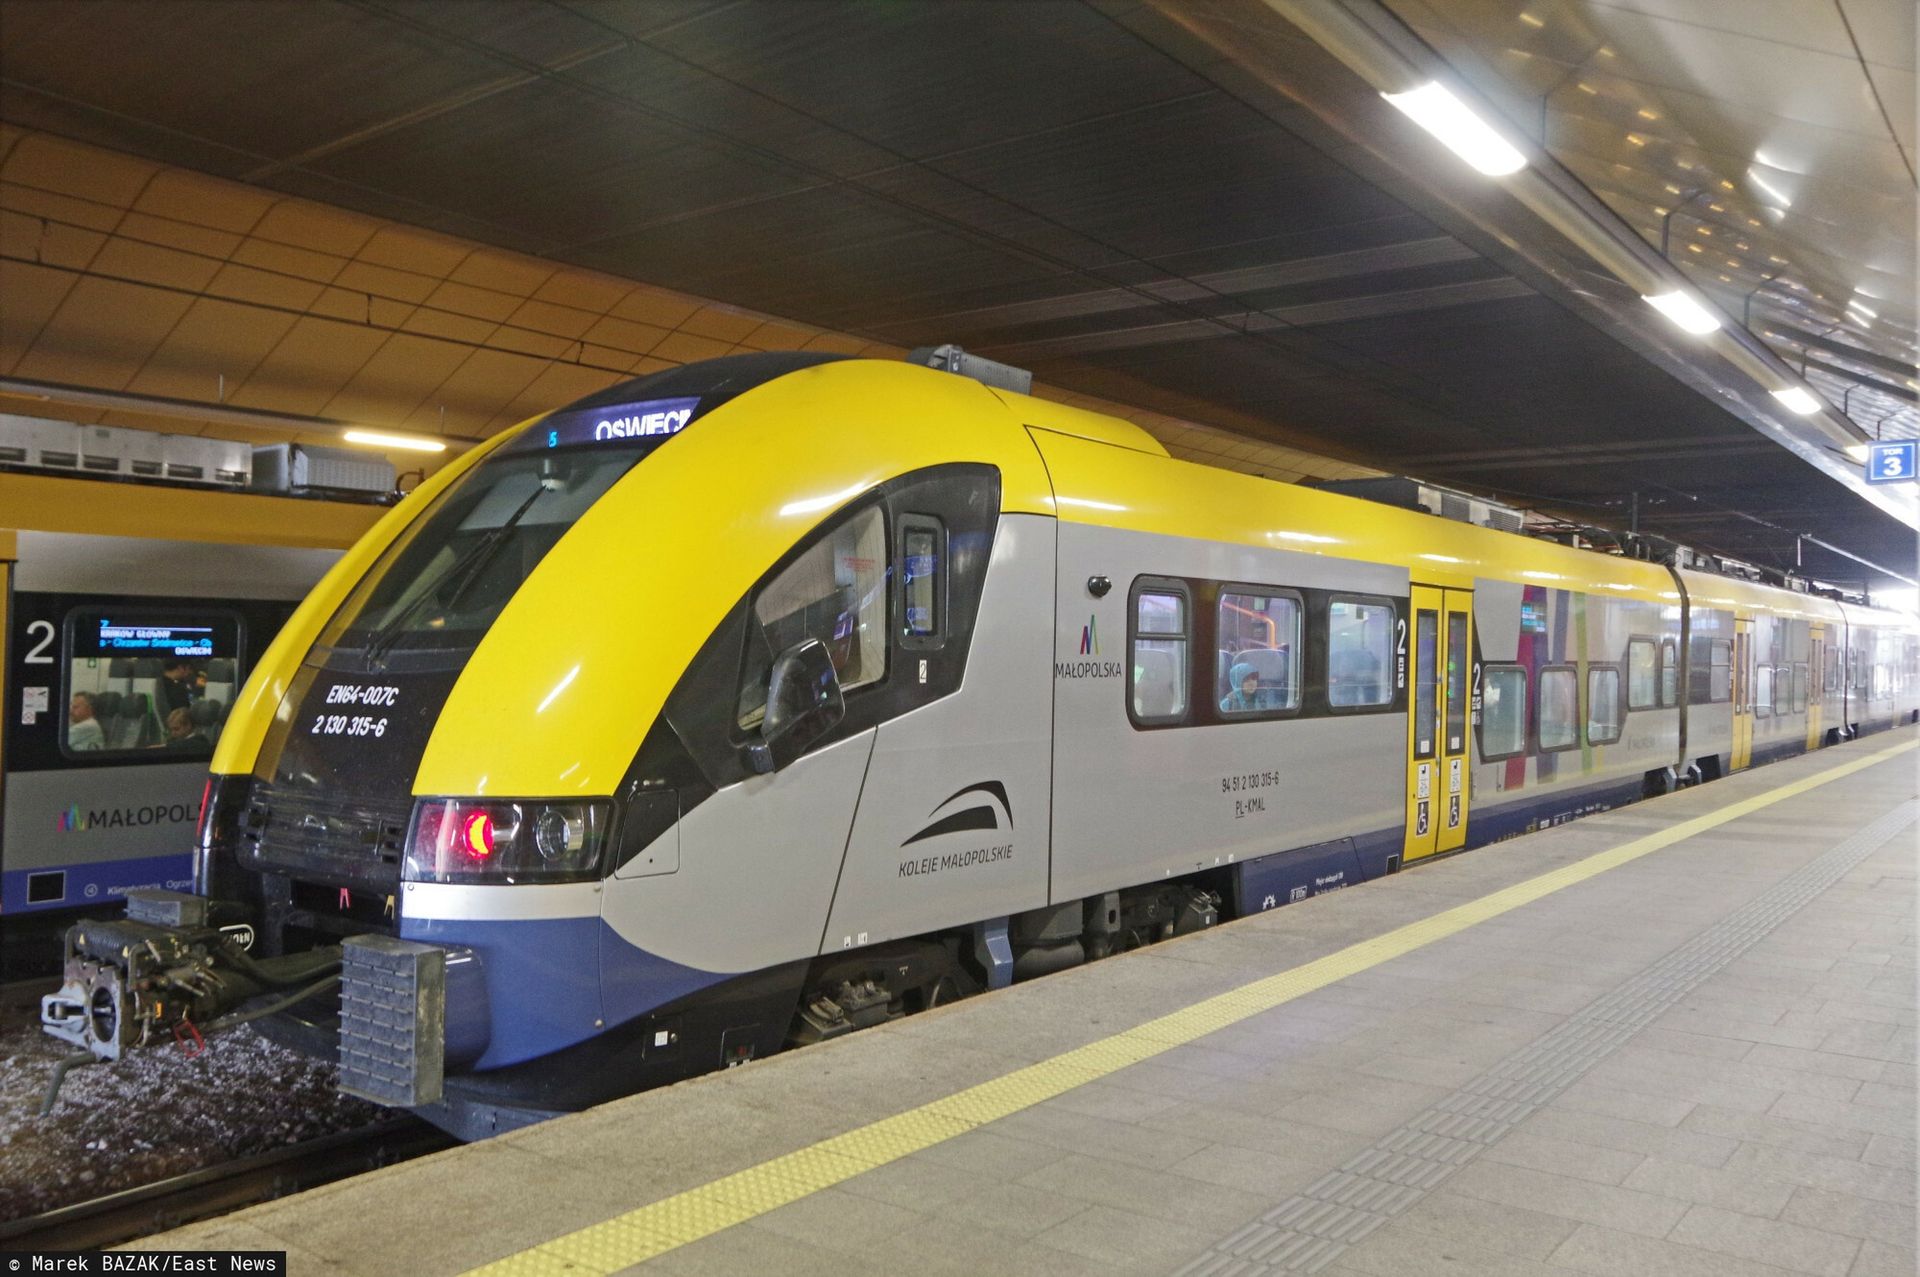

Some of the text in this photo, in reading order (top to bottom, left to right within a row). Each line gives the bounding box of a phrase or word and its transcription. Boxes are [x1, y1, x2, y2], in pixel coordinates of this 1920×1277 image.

[549, 431, 557, 447] 5
[1883, 457, 1903, 476] 3
[24, 619, 55, 664] 2
[1397, 618, 1406, 654] 2
[920, 662, 927, 680] 2
[1055, 662, 1122, 679] MAŁOPOLSKA
[1473, 662, 1481, 694] 2
[326, 685, 399, 706] EN64-007C
[312, 715, 388, 737] 2 130 315-6
[1222, 771, 1279, 793] 94 51 2 130 315-6
[899, 844, 1013, 877] KOLEJE MAŁOPOLSKIE
